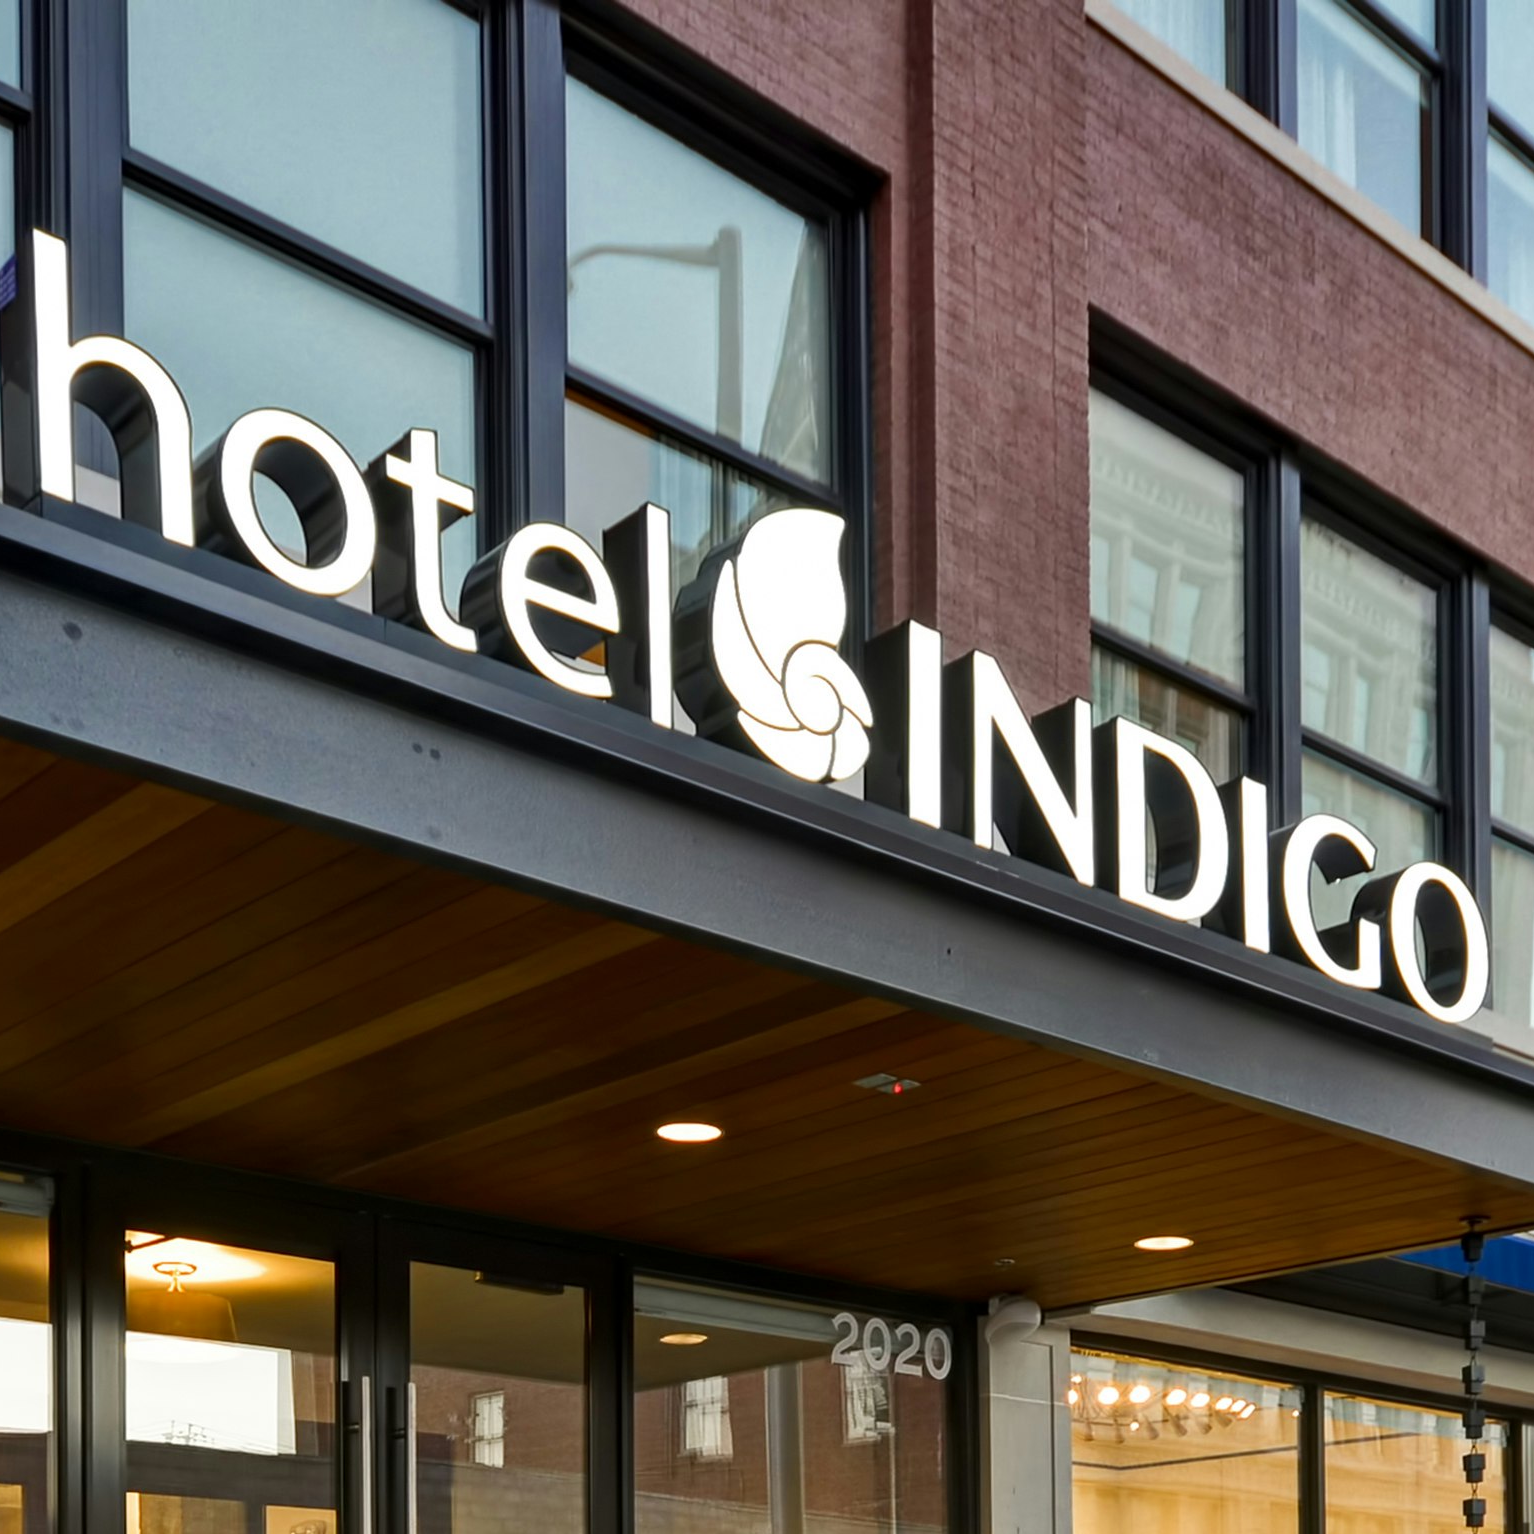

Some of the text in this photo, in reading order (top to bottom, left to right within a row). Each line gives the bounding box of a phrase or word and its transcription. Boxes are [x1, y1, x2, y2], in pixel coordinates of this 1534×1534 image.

[31, 226, 1491, 1024] hotel INDIGO
[830, 1312, 953, 1381] 2020
